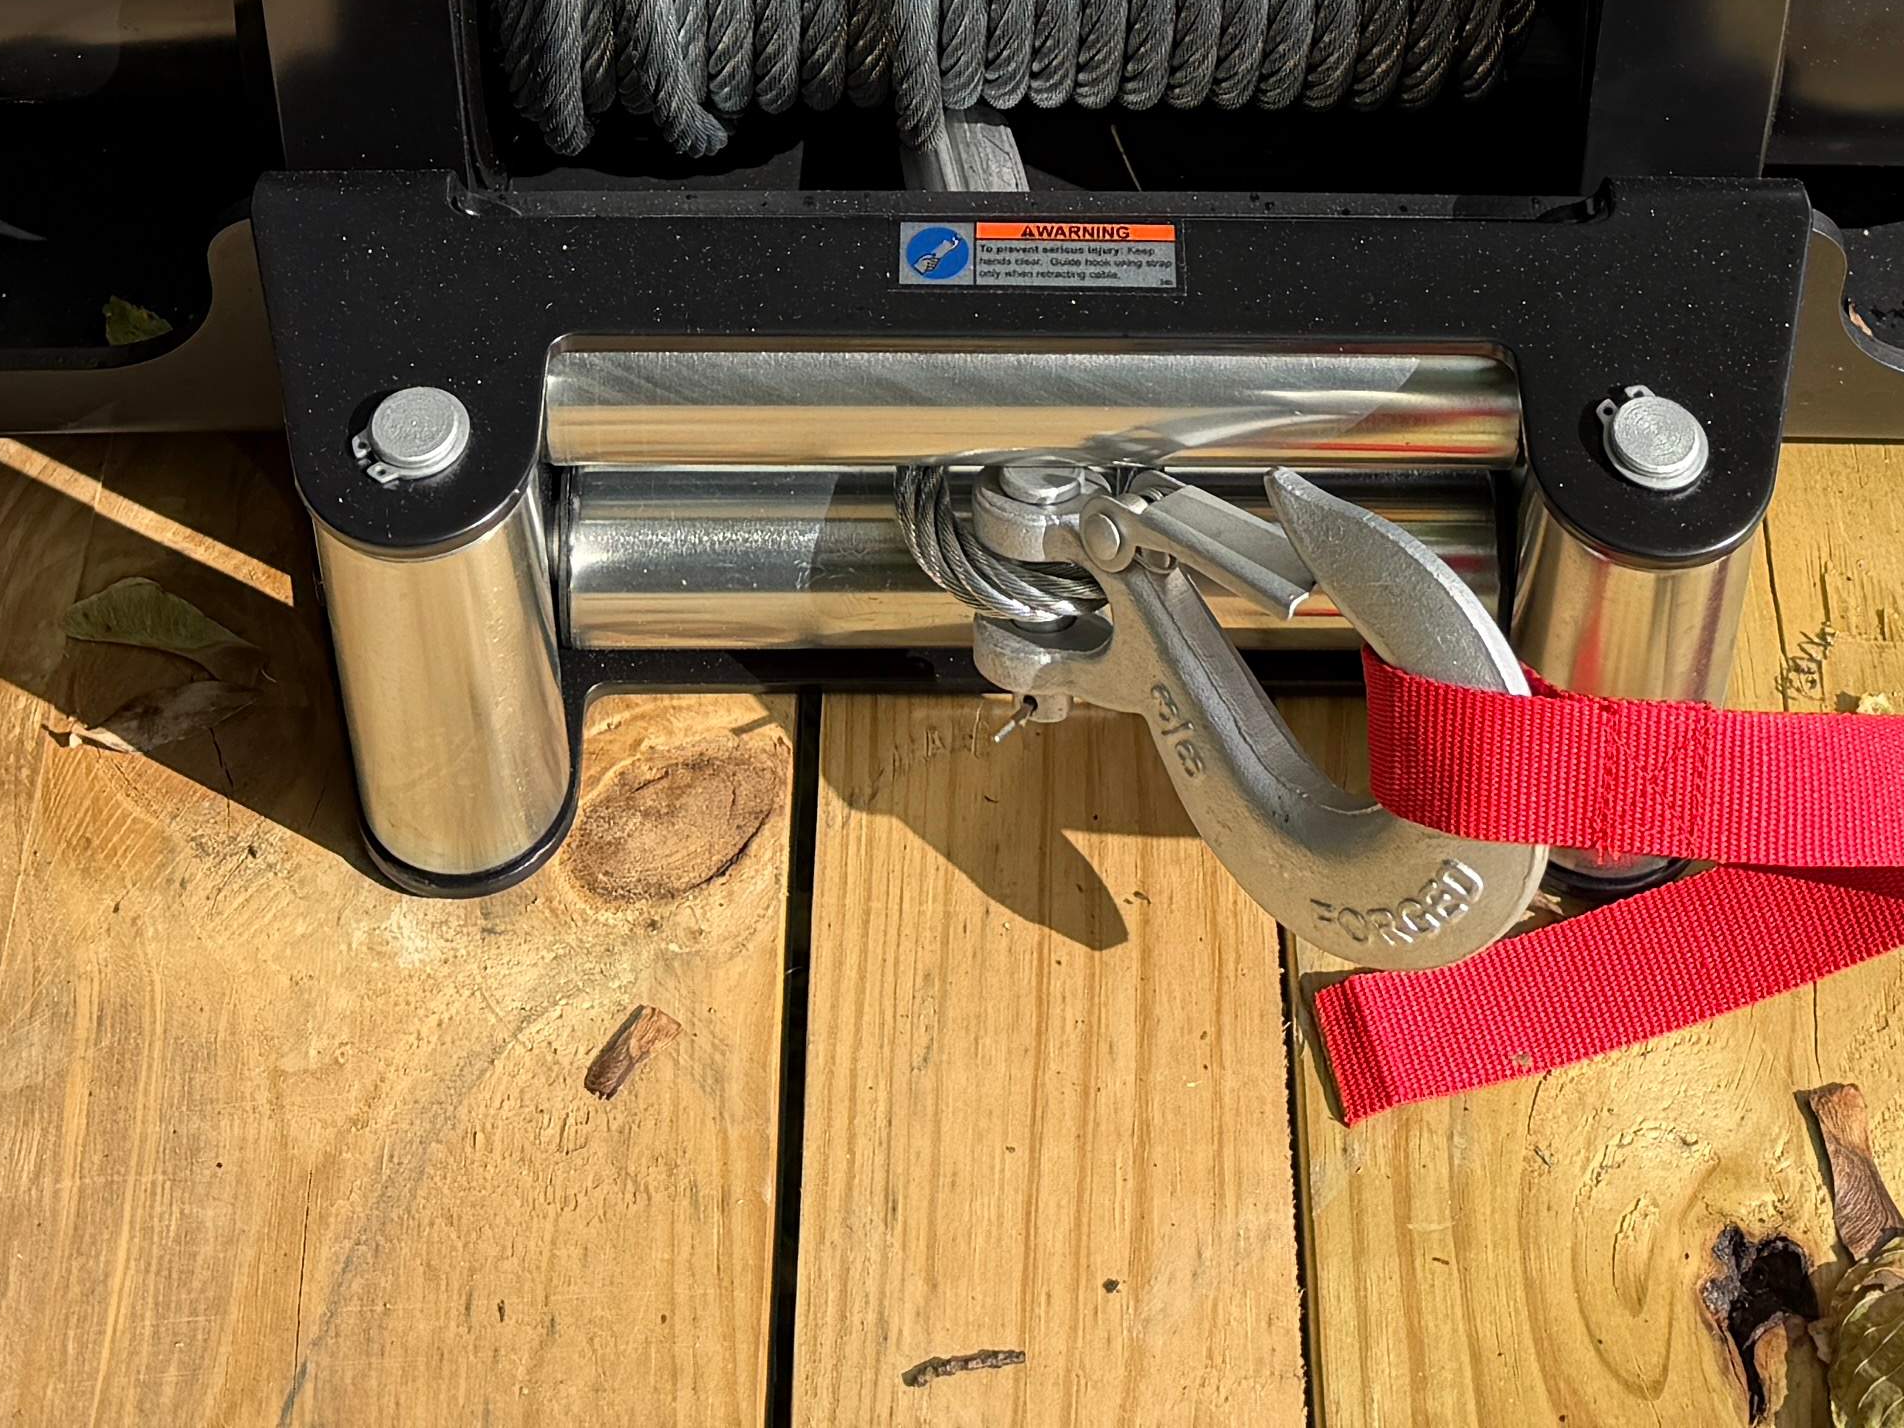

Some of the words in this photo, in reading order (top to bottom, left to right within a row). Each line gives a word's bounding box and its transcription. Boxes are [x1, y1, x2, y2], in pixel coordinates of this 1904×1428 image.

[1036, 225, 1132, 240] WARNING
[978, 245, 994, 256] To
[995, 245, 1039, 256] prevent
[1041, 245, 1085, 256] serious
[1126, 245, 1155, 256] Keep
[978, 257, 1012, 268] hands
[1049, 257, 1082, 268] Guide
[1084, 257, 1111, 268] hook
[1113, 257, 1143, 268] using
[1145, 257, 1172, 268] strap
[978, 269, 1002, 281] only
[1003, 269, 1033, 281] when
[1035, 269, 1086, 281] retracting
[1309, 857, 1486, 946] FORGED
